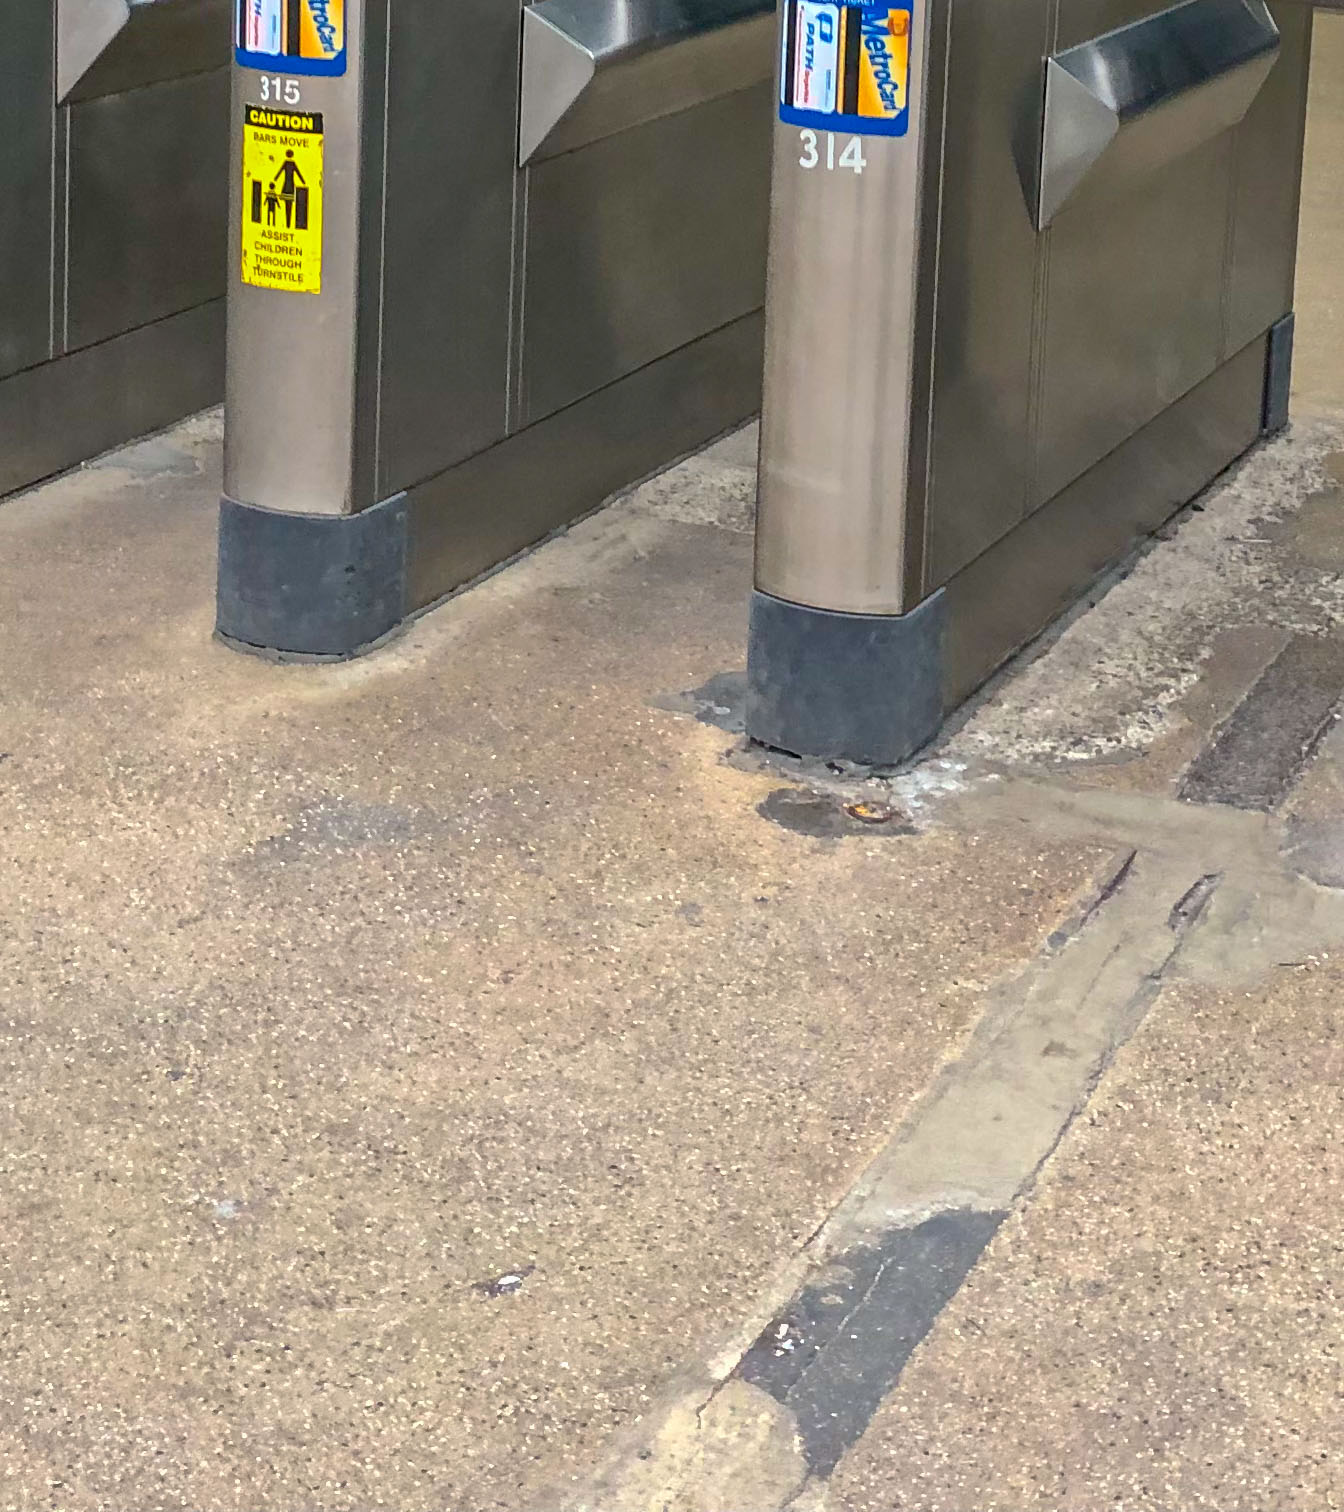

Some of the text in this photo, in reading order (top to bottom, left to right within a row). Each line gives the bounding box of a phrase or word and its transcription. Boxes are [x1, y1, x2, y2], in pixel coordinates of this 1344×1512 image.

[805, 22, 816, 72] PATH
[260, 75, 301, 105] 315
[249, 109, 314, 131] CAUTION
[253, 131, 310, 149] BARS MOVE
[798, 128, 867, 174] 314
[260, 229, 295, 243] ASSIST
[254, 240, 303, 257] CHILDREN
[254, 253, 302, 269] THROUGH
[252, 265, 304, 283] TURNSTILE
